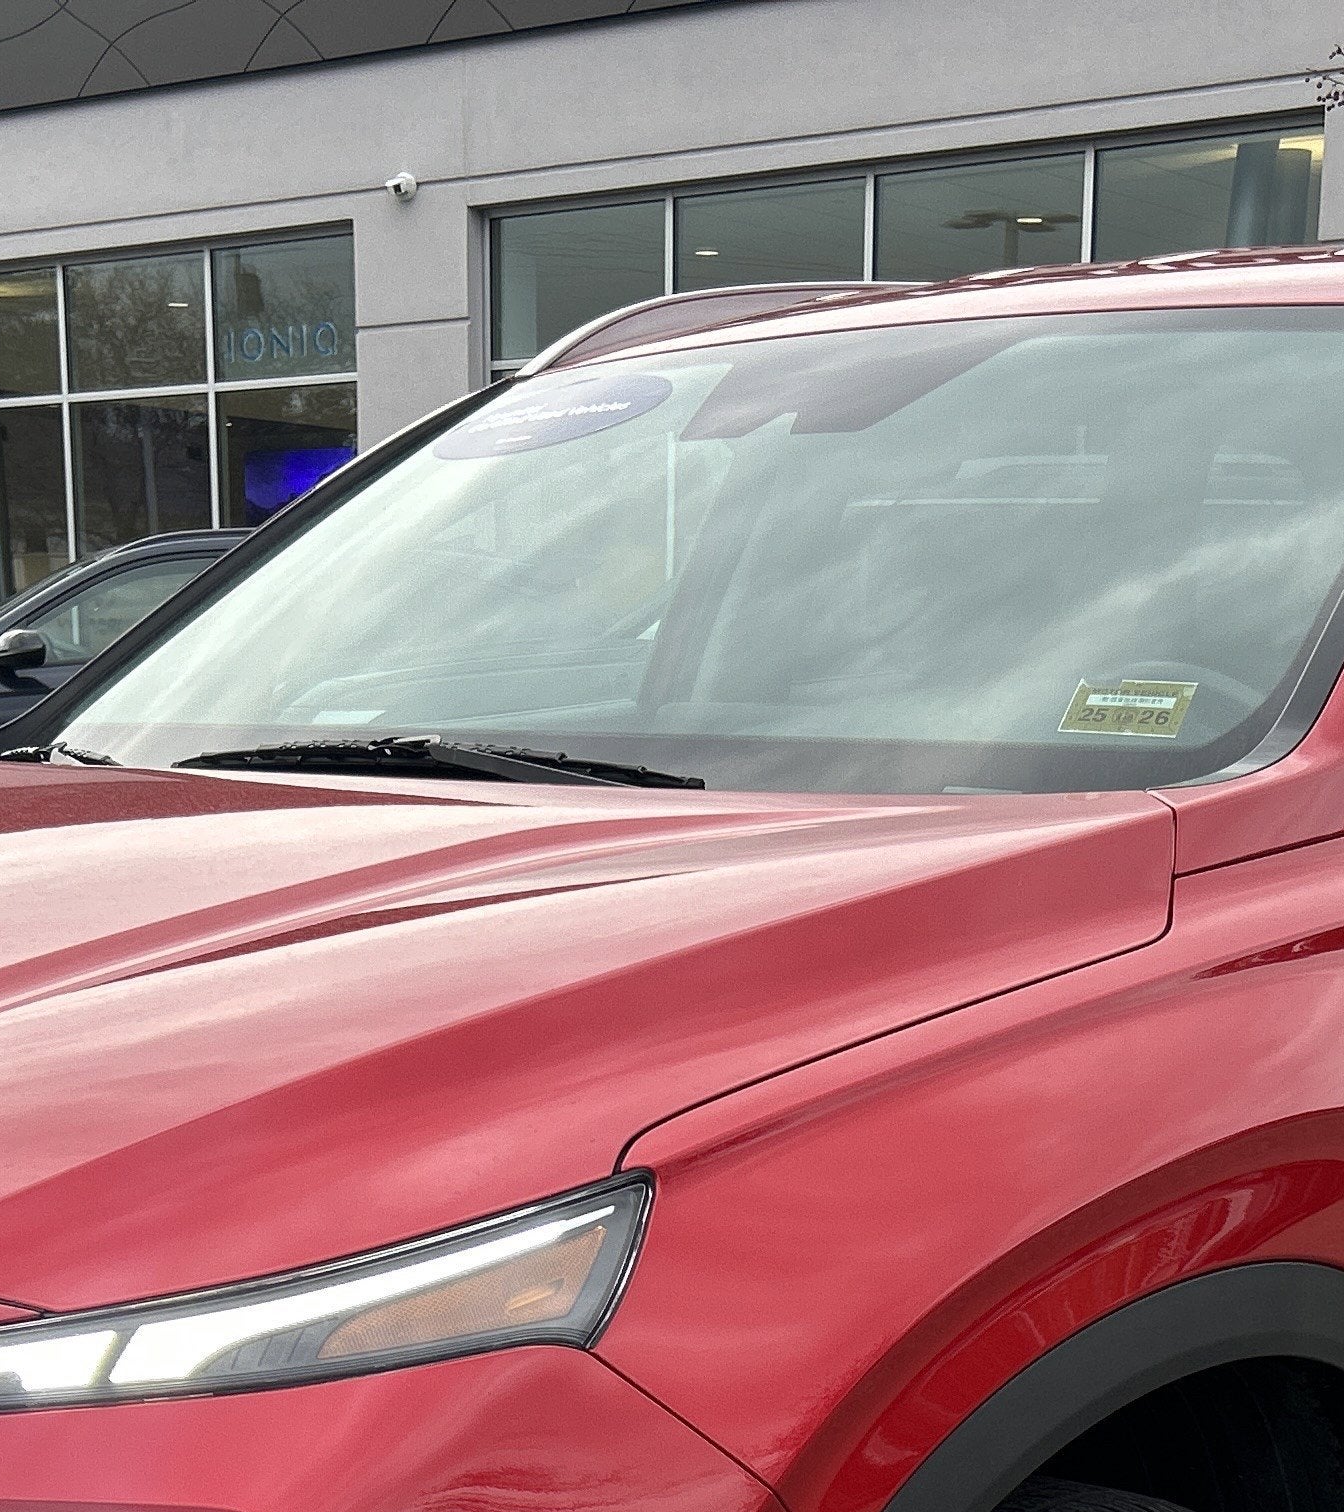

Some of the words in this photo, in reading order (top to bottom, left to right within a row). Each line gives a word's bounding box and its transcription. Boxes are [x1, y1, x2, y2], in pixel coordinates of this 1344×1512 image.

[225, 321, 337, 363] IONIQ
[1078, 707, 1108, 723] 25
[1138, 709, 1171, 726] 26
